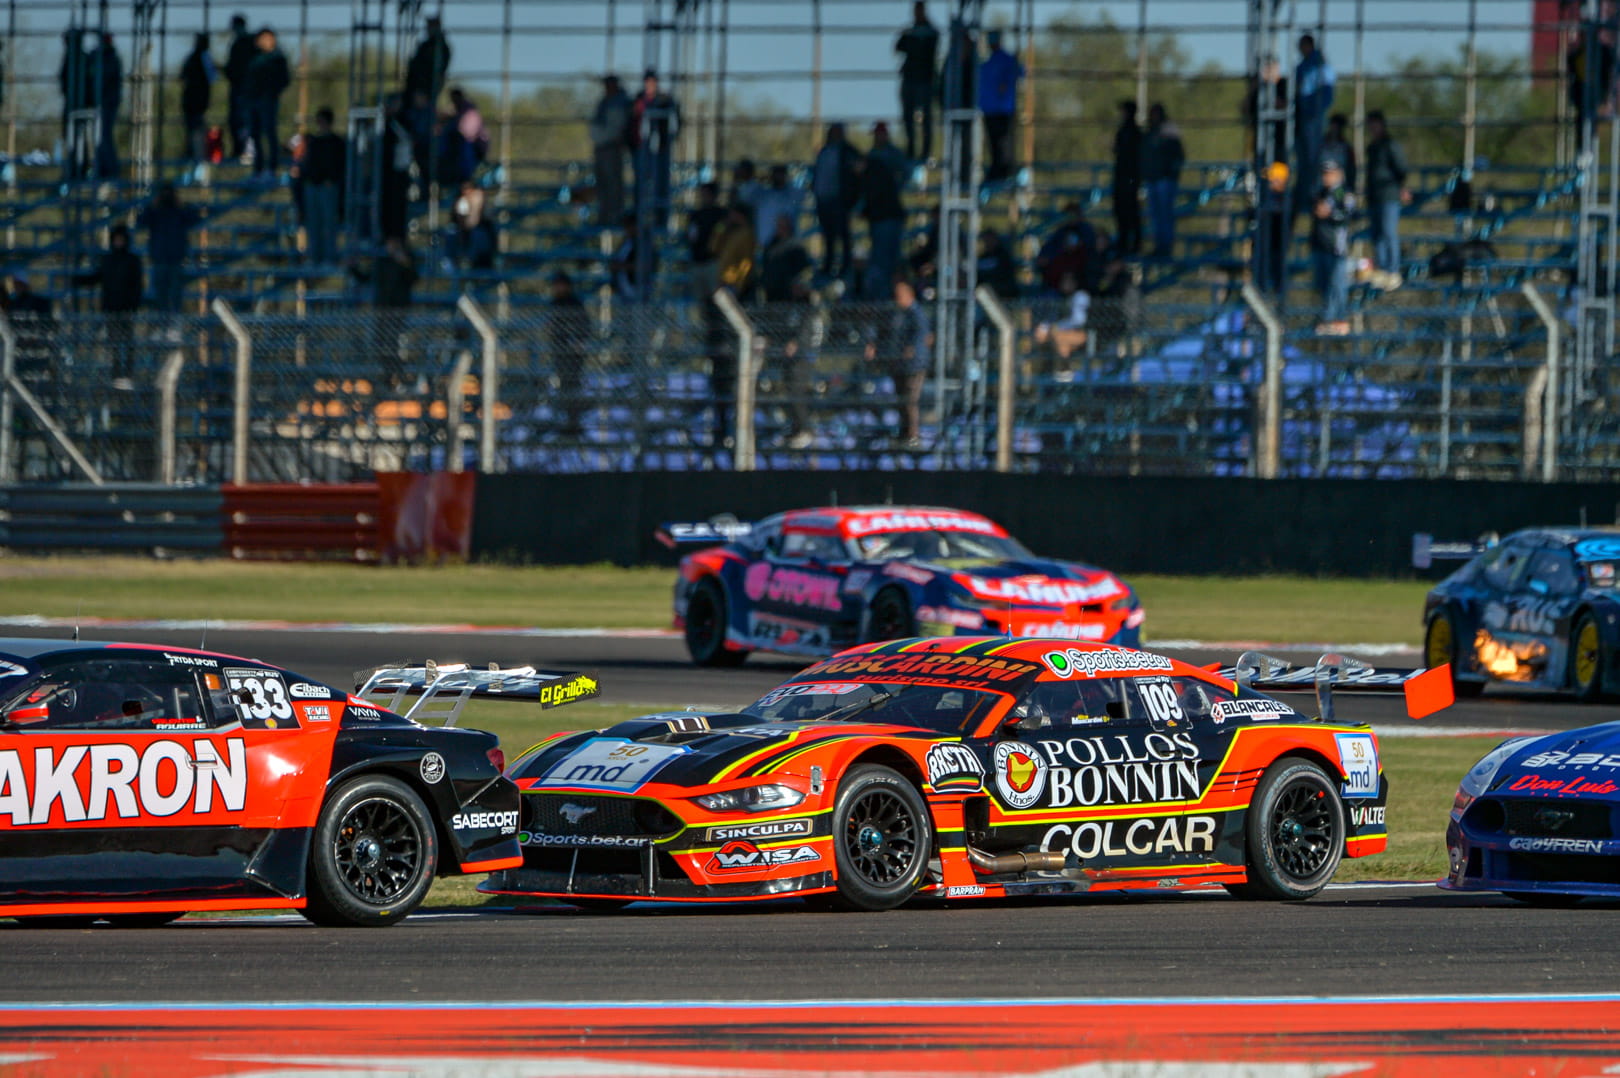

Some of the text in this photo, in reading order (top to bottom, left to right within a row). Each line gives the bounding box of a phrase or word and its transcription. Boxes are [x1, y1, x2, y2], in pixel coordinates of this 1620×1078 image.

[289, 683, 330, 694] Eibach
[541, 687, 552, 703] El
[1139, 683, 1183, 720] 109
[609, 745, 649, 757] 50
[998, 743, 1044, 770] BONNIN
[1037, 732, 1200, 767] POLLOS
[1351, 742, 1365, 758] 50
[565, 762, 634, 783] md
[929, 745, 981, 784] RASTA
[0, 737, 247, 826] AKRON
[1048, 758, 1202, 807] BONNIN
[1350, 765, 1370, 788] md
[1509, 774, 1619, 794] Don Luis
[452, 811, 518, 829] SABECORT
[532, 832, 649, 847] Sports.bet.ar
[715, 823, 805, 839] SINCULPA
[1039, 815, 1217, 860] COLCAR
[715, 846, 820, 865] WISA
